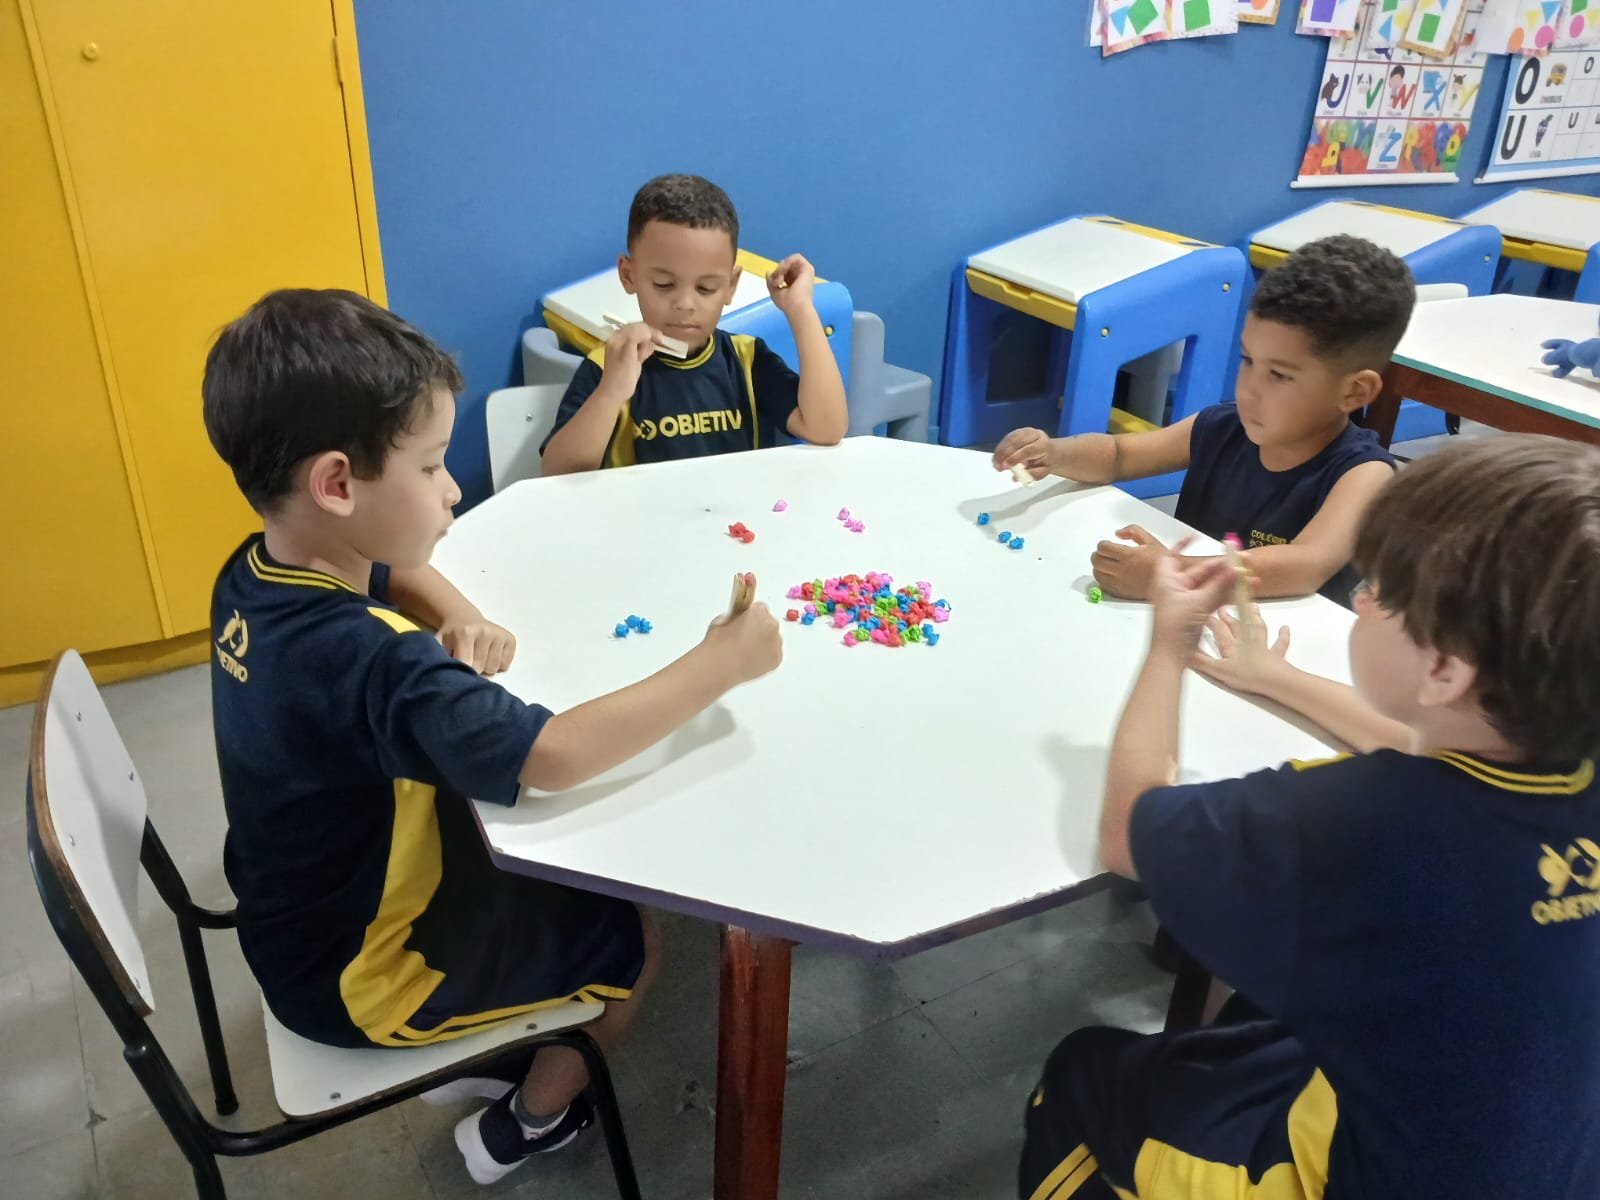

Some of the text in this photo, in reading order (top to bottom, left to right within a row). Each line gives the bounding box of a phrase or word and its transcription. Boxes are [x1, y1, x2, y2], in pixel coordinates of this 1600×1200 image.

[1326, 73, 1350, 109] U
[1365, 77, 1385, 109] V
[1391, 82, 1417, 111] W
[1423, 80, 1447, 112] X
[1515, 56, 1595, 105] O O
[1378, 131, 1403, 163] Z
[1500, 114, 1528, 161] U
[1567, 111, 1580, 129] U
